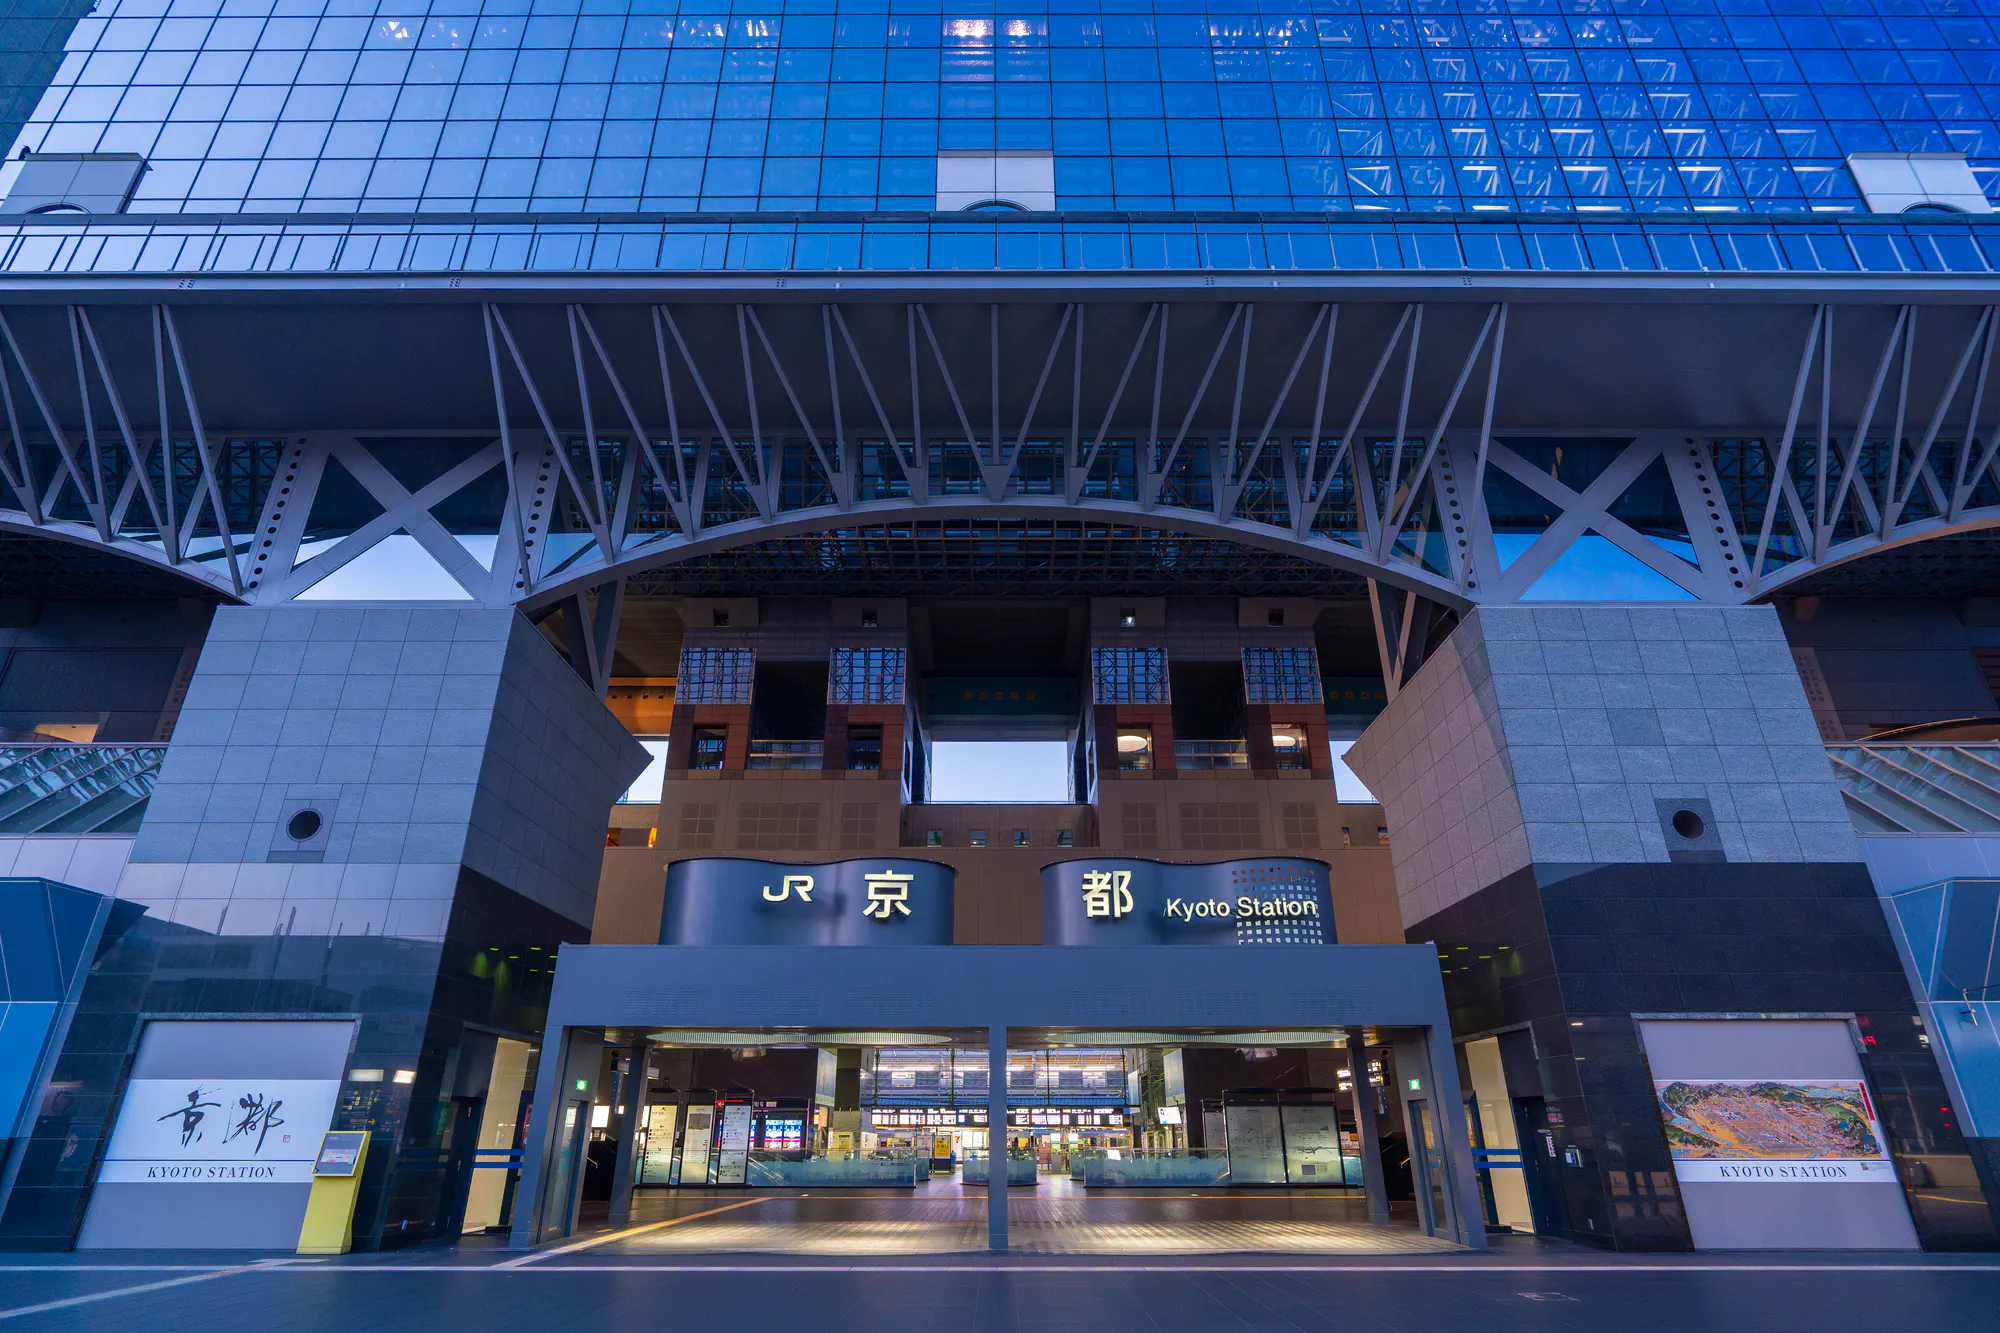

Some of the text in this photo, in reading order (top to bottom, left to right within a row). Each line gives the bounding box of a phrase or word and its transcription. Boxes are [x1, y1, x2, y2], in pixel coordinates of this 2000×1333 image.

[763, 875, 814, 902] JR
[1165, 897, 1317, 922] Kyoto Station
[147, 1166, 276, 1178] KYOTO STATION
[1720, 1166, 1848, 1178] KYOTO STATION
